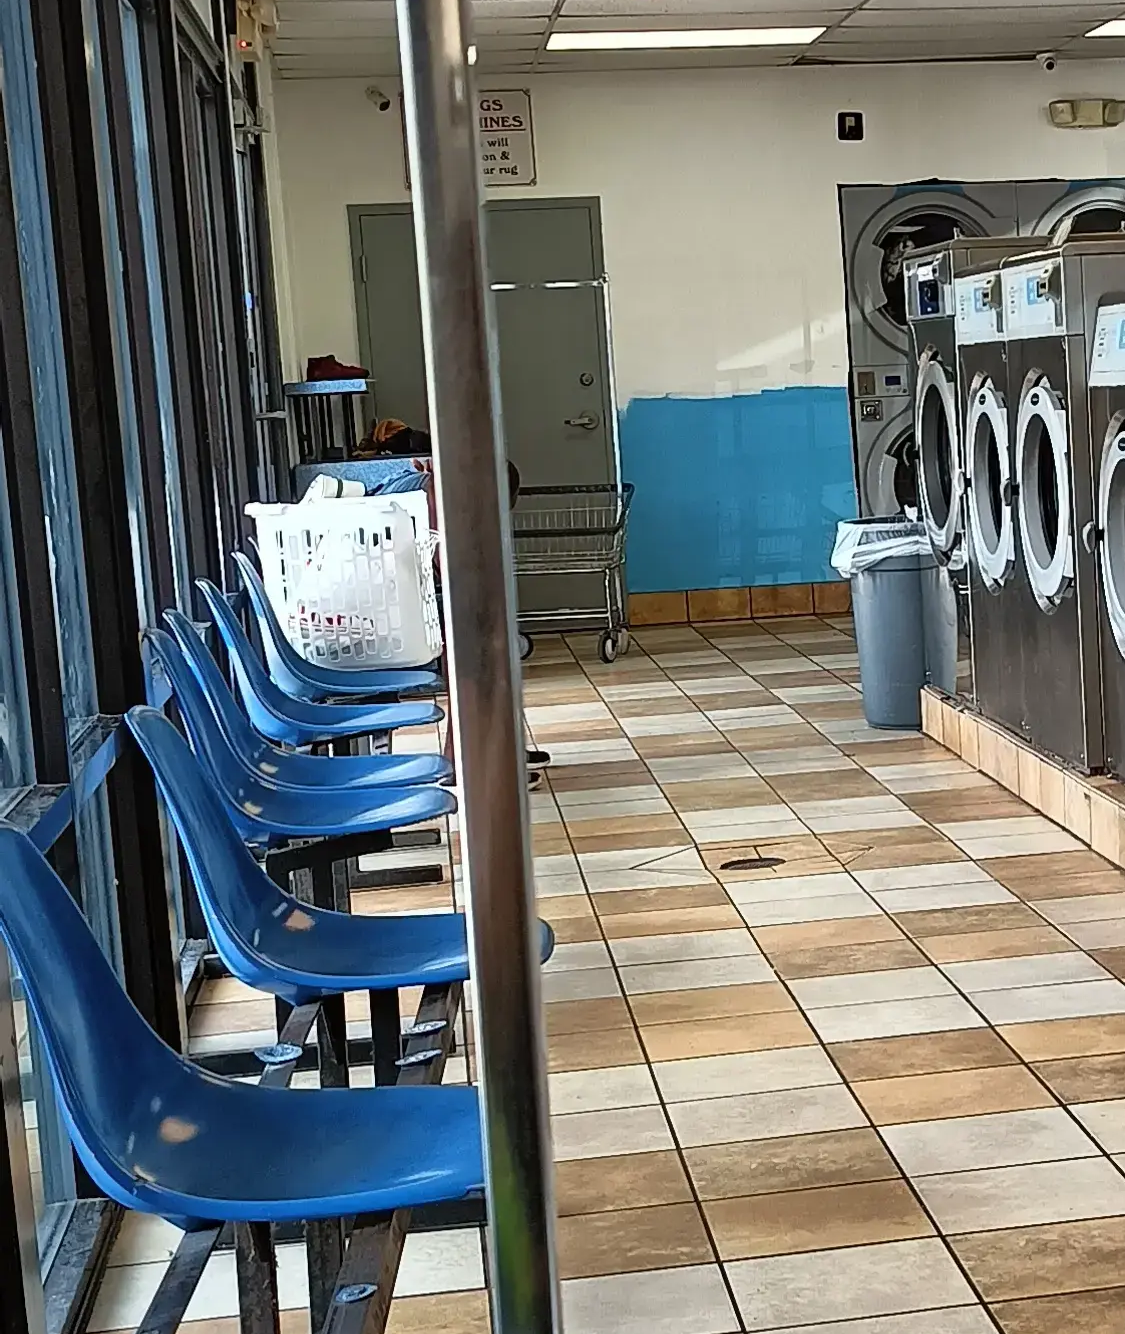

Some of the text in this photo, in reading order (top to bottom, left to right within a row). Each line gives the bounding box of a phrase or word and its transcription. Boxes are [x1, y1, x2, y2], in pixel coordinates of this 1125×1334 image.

[487, 137, 509, 147] will
[500, 150, 510, 161] &
[499, 165, 518, 176] rug
